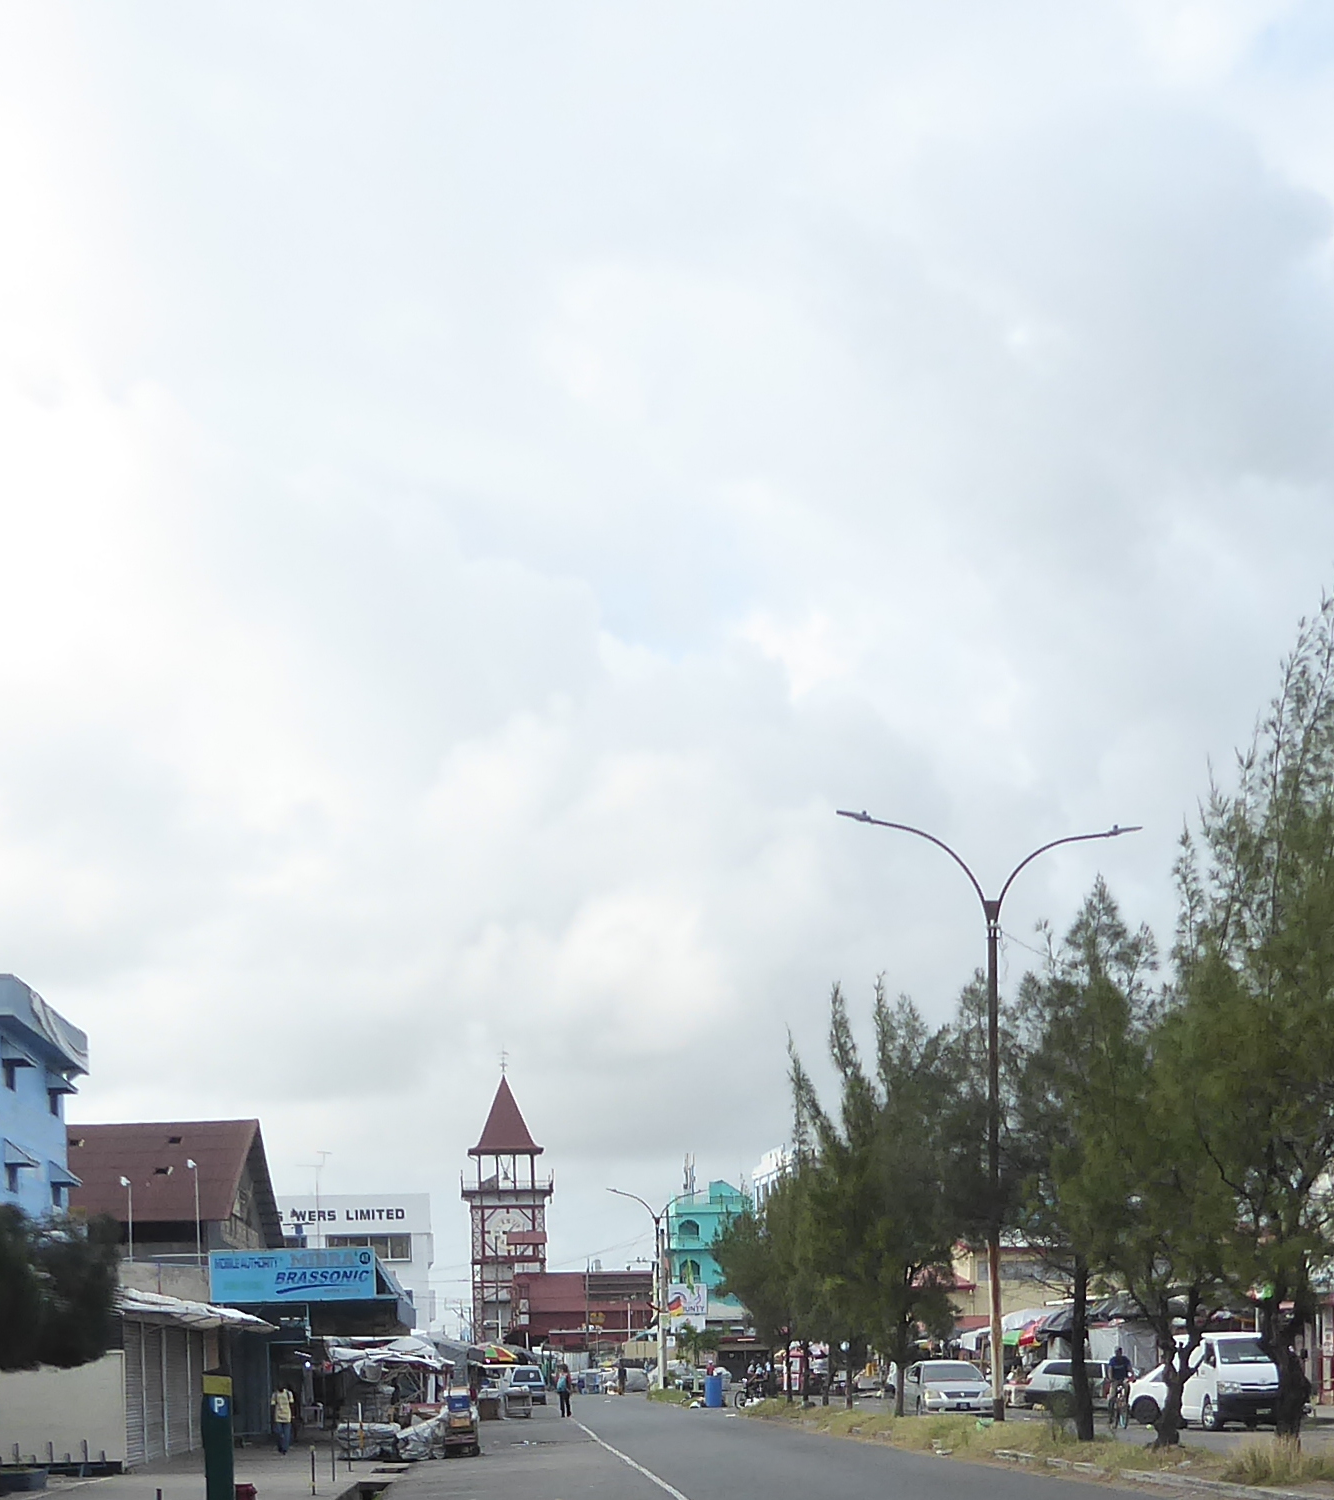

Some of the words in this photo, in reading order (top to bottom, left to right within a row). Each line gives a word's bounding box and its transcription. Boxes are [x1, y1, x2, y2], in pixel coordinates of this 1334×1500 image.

[346, 1208, 405, 1221] LIMITED
[274, 1270, 371, 1286] BRASSONIC
[214, 1397, 225, 1413] P
